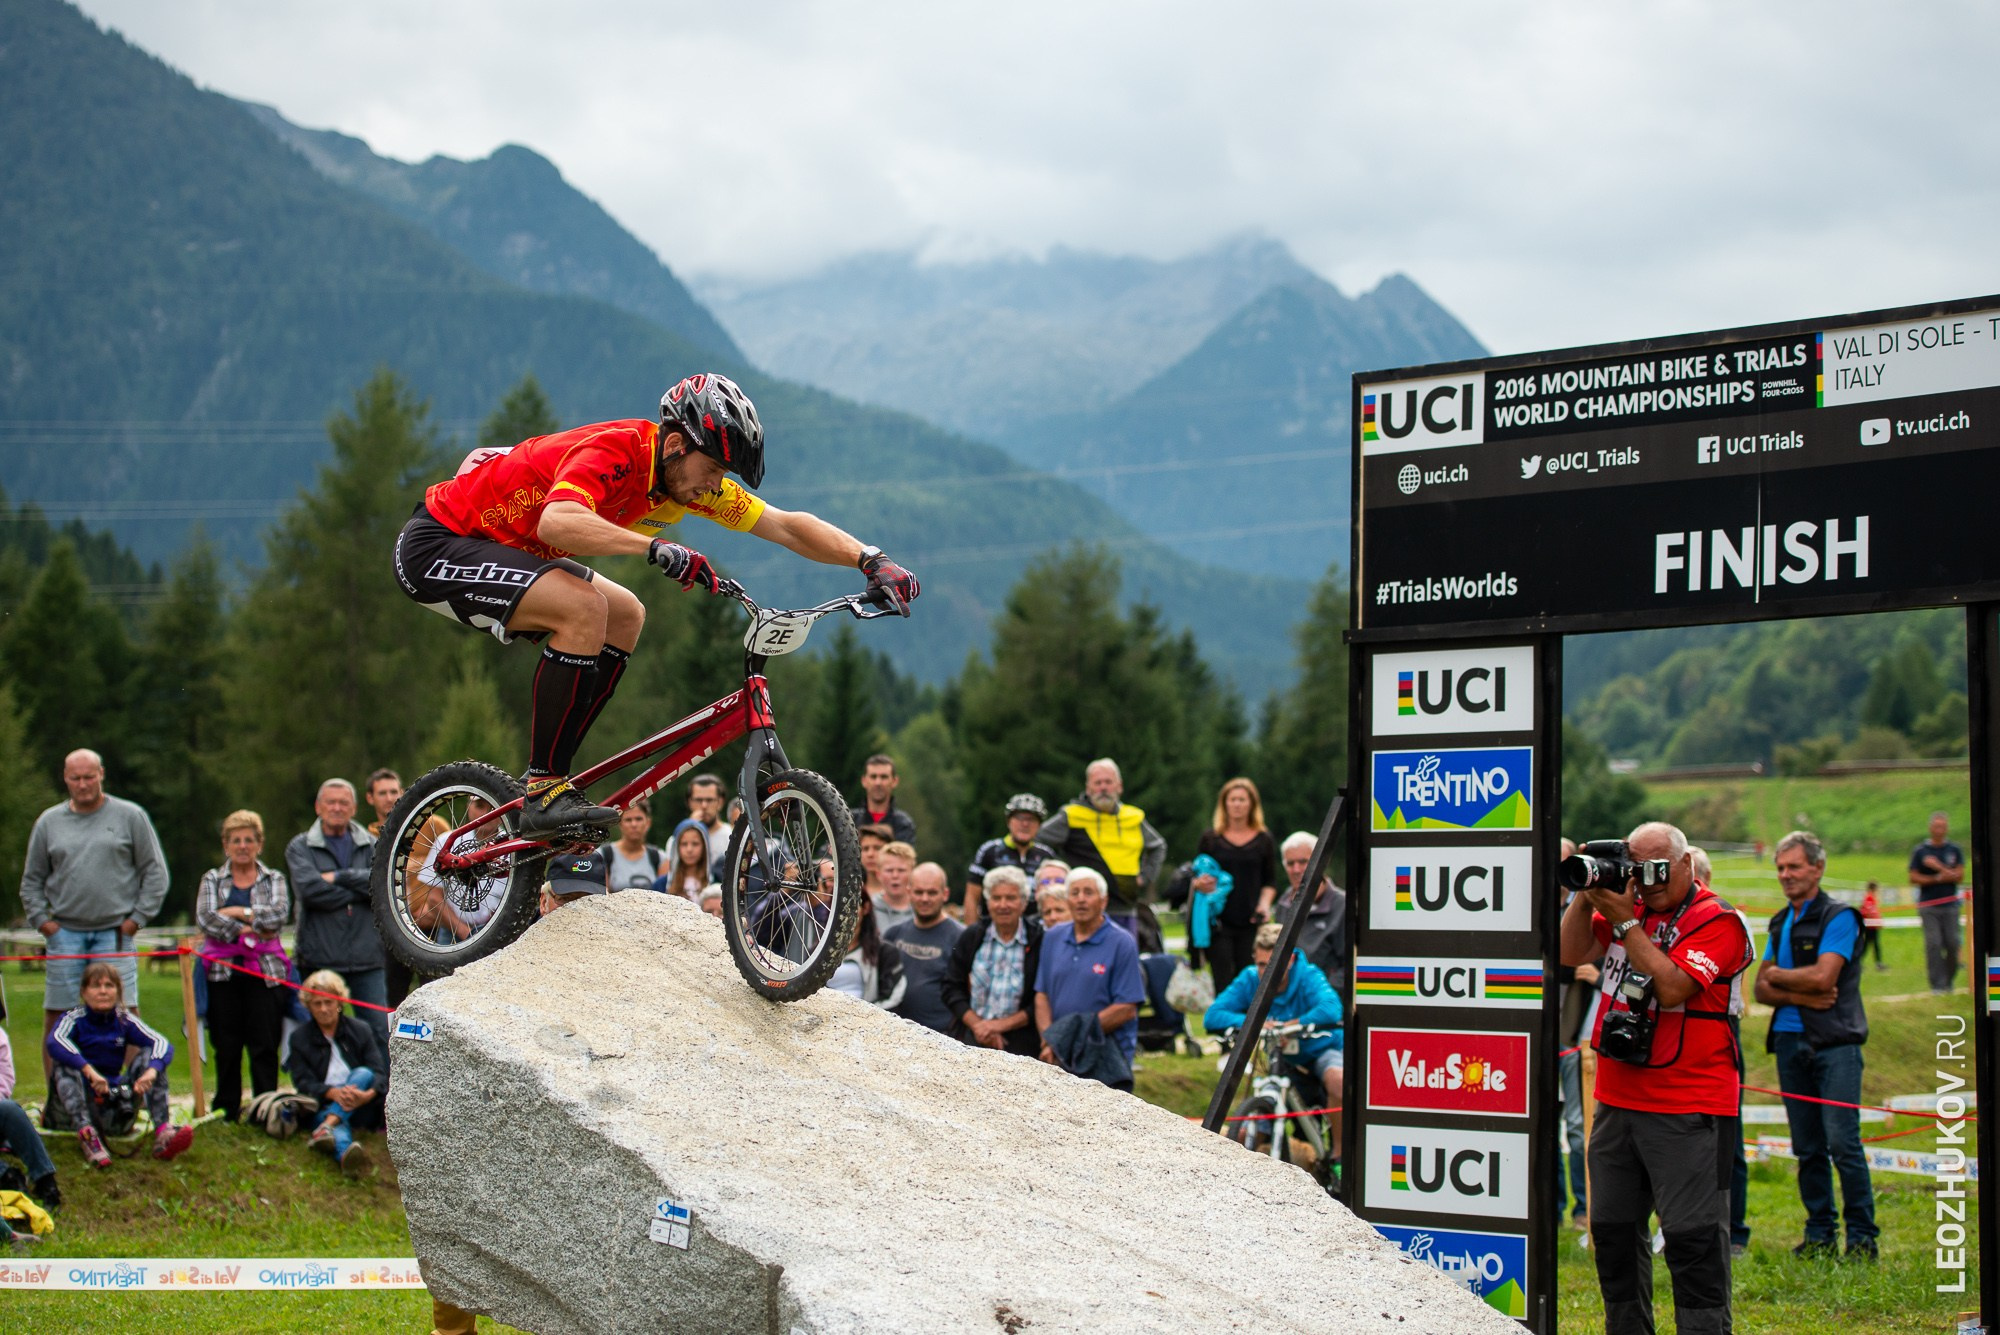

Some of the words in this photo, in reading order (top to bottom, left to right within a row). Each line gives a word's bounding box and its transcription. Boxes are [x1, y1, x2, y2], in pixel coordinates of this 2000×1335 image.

[1833, 335, 1872, 360] VAL
[1879, 331, 1899, 355] DI
[1907, 322, 1965, 351] SOLE
[1494, 375, 1537, 401] 2016
[1541, 361, 1656, 395] MOUNTAIN
[1661, 356, 1708, 382] BIKE
[1713, 353, 1731, 376] &
[1733, 343, 1808, 373] TRIALS
[1762, 378, 1798, 390] DOWNHILL
[1834, 363, 1886, 391] ITALY
[1494, 400, 1569, 429] WORLD
[1573, 379, 1755, 420] CHAMPIONSHIPS
[1762, 385, 1805, 399] FOUR-CROSS
[1380, 383, 1474, 440] UCI
[1896, 410, 1971, 437] tv.uci.ch
[1726, 436, 1757, 456] UCI
[1760, 430, 1805, 452] Trials
[1424, 463, 1469, 486] uci.ch
[1546, 446, 1641, 475] @UCI_Trials
[1655, 515, 1871, 595] FINISH
[424, 559, 538, 588] hebo
[1376, 571, 1519, 607] #TrialsWorlds
[473, 594, 513, 607] CLEAN
[764, 629, 794, 645] 2E
[560, 656, 594, 666] hebo
[1417, 667, 1506, 716] UCI
[1393, 764, 1510, 807] TRENTINO
[1415, 865, 1504, 912] UCI
[1418, 967, 1476, 999] UCI
[1388, 1049, 1425, 1090] Val
[1427, 1071, 1445, 1089] di
[1446, 1052, 1507, 1093] Sole
[1411, 1146, 1500, 1198] UCI
